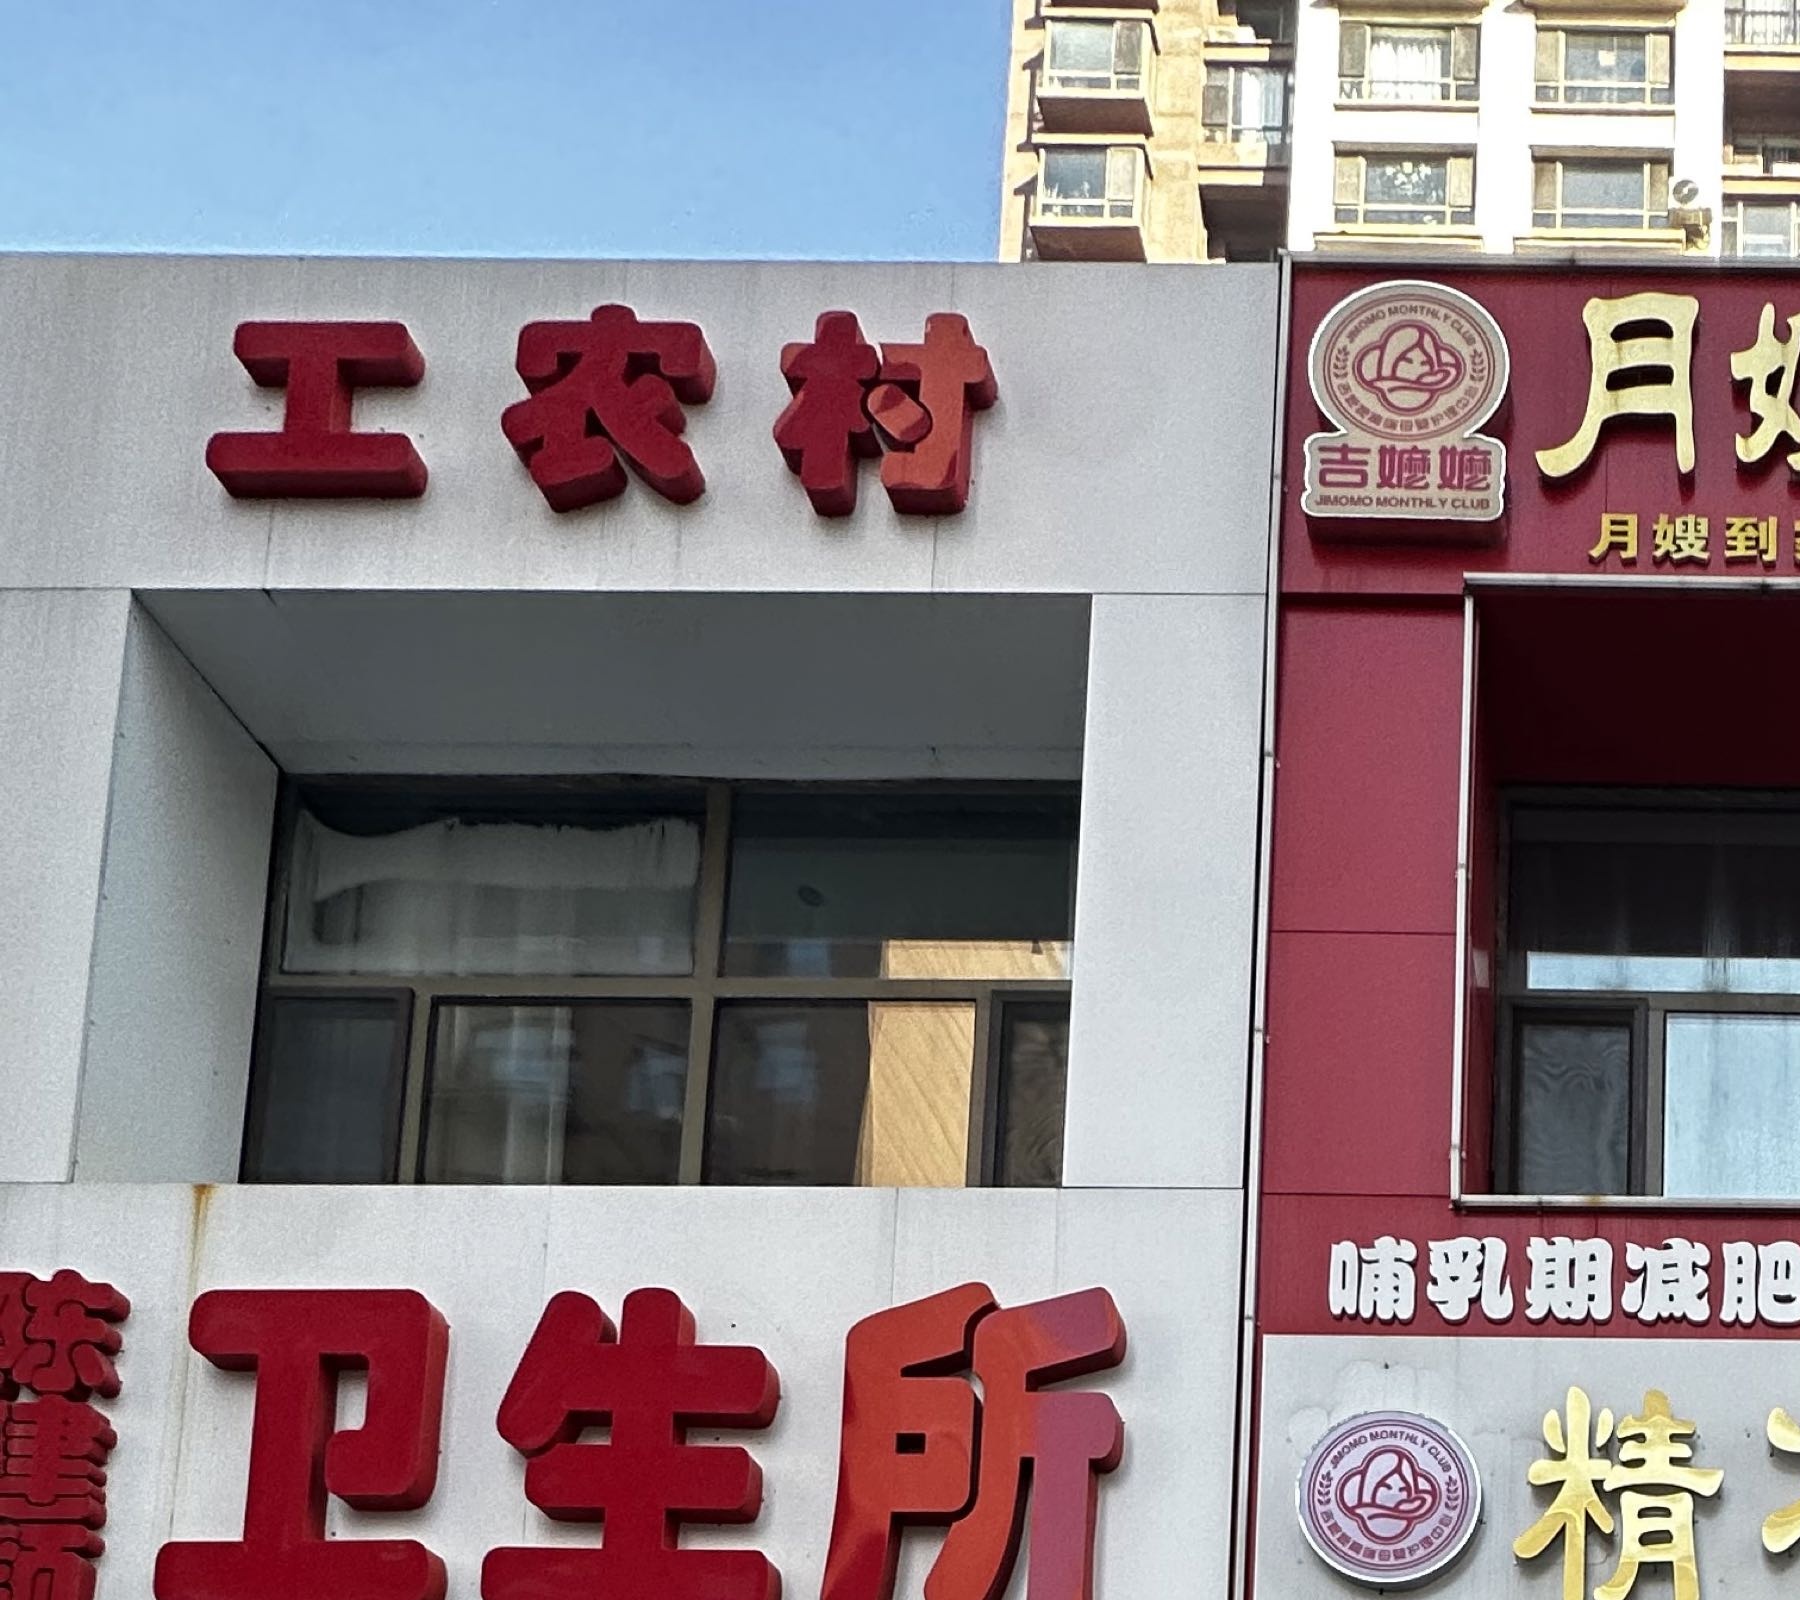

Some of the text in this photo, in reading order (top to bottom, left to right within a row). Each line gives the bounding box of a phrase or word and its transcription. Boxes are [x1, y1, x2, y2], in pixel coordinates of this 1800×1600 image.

[1388, 304, 1450, 323] MONTHLY
[1450, 319, 1477, 347] CLUB
[206, 305, 998, 517] 工农村
[1315, 495, 1490, 511] JIMOMO MONTHLY CLUB
[1370, 1429, 1429, 1449] MONTHLY
[1428, 1446, 1453, 1474] CLUB
